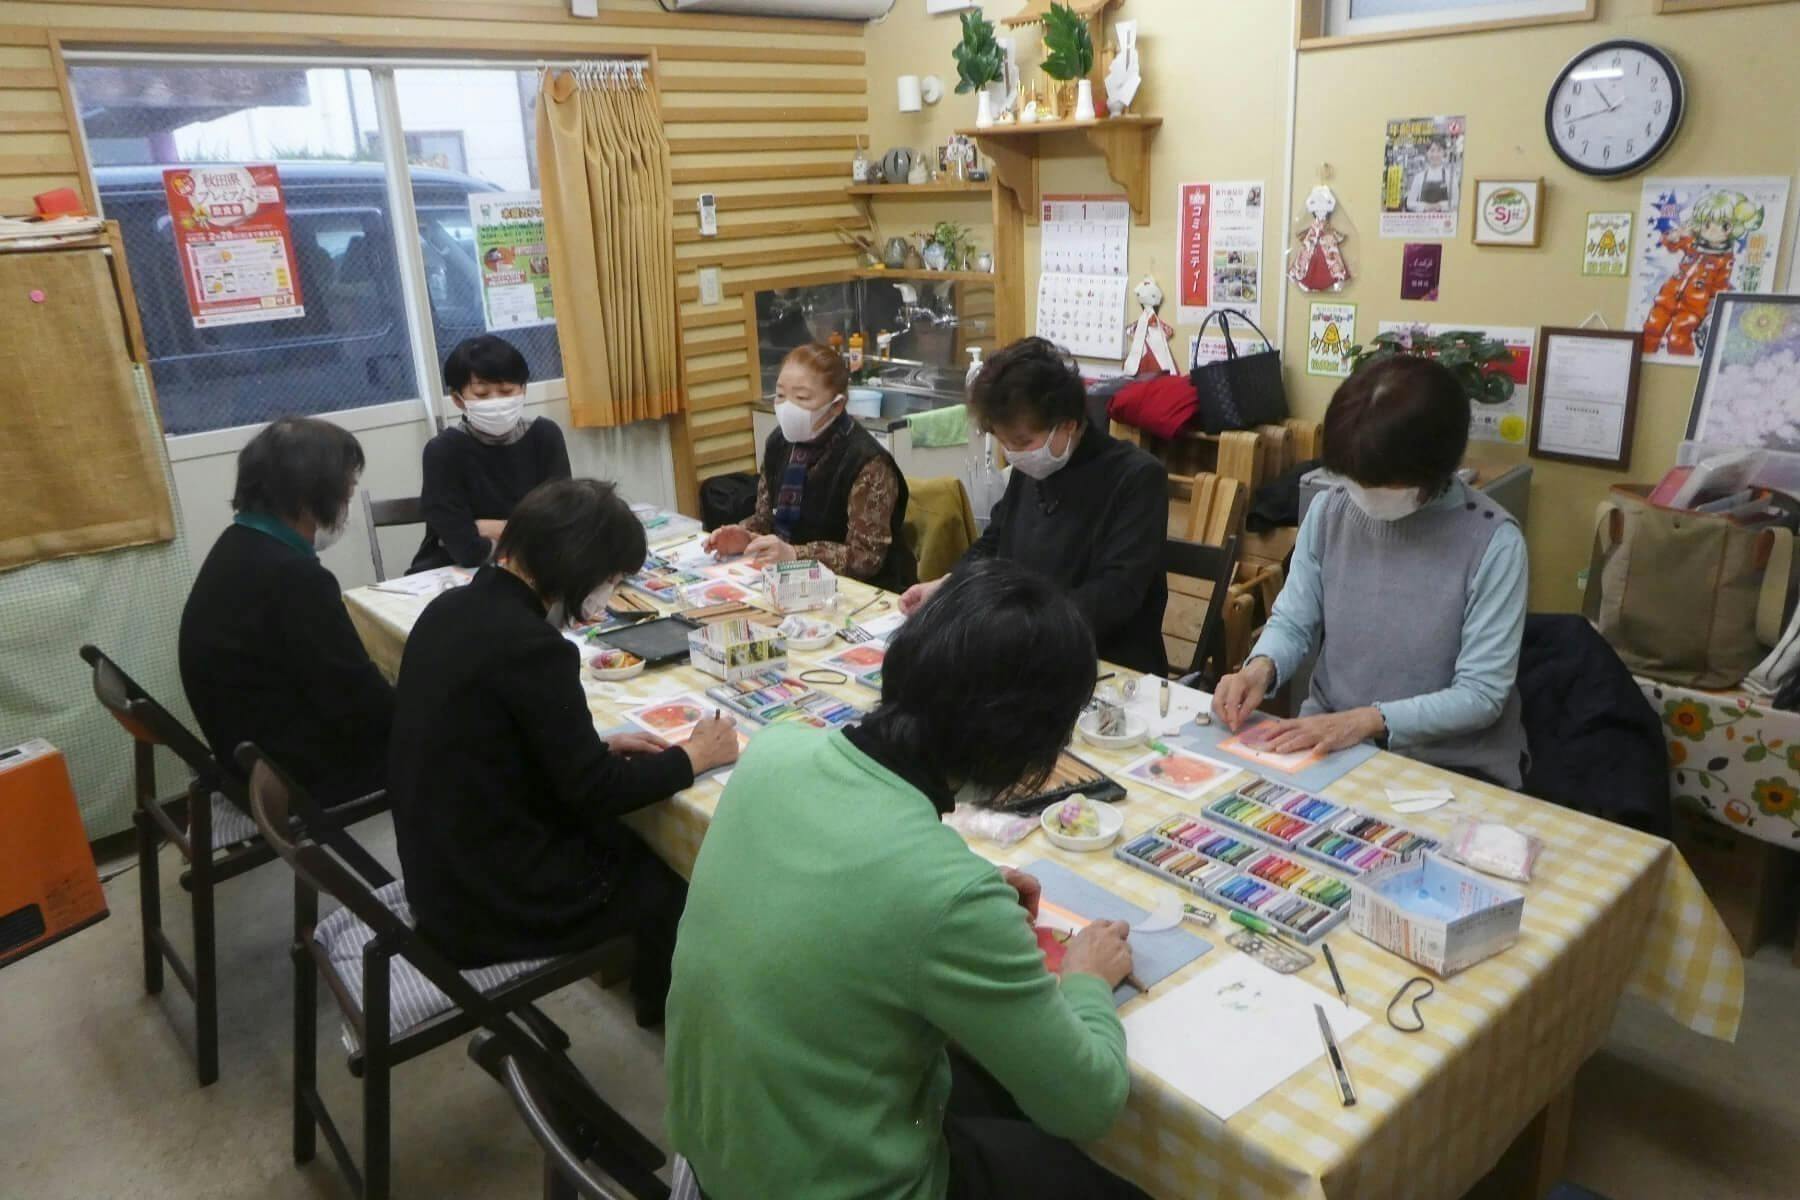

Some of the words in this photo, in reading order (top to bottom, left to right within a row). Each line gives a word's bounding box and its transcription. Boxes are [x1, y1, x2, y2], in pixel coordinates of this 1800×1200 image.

[1572, 81, 1582, 96] 10
[1650, 76, 1657, 93] 2
[1654, 99, 1662, 114] 3
[1569, 124, 1576, 140] 8
[1645, 121, 1651, 137] 4
[1582, 140, 1589, 155] 7
[1604, 145, 1610, 160] 6
[1626, 138, 1633, 154] 5
[1082, 204, 1087, 220] 1
[1190, 206, 1203, 293] コミュニティー
